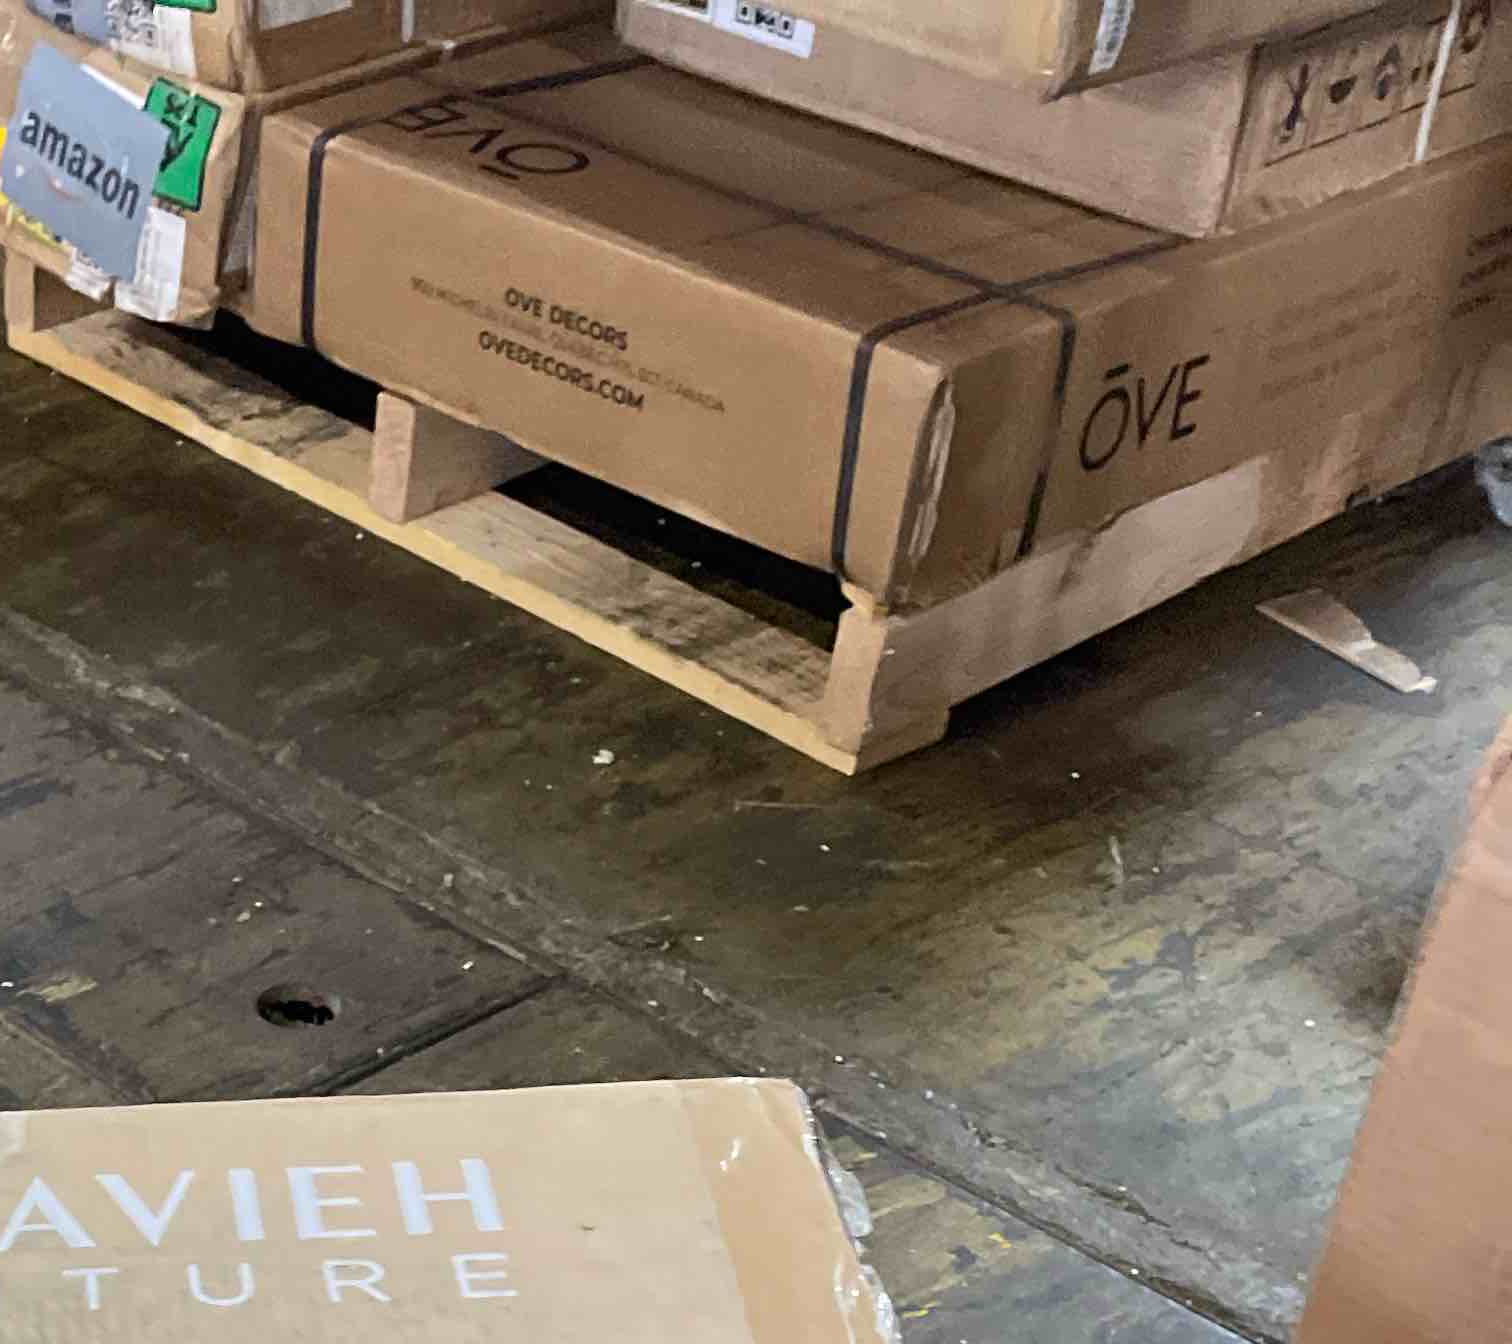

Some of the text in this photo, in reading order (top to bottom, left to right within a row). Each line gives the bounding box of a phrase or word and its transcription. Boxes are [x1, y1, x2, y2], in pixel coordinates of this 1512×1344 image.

[19, 104, 143, 222] amazon
[504, 285, 545, 322] OVE
[550, 302, 630, 351] DECORS
[478, 330, 645, 413] OVEDECORS.COM
